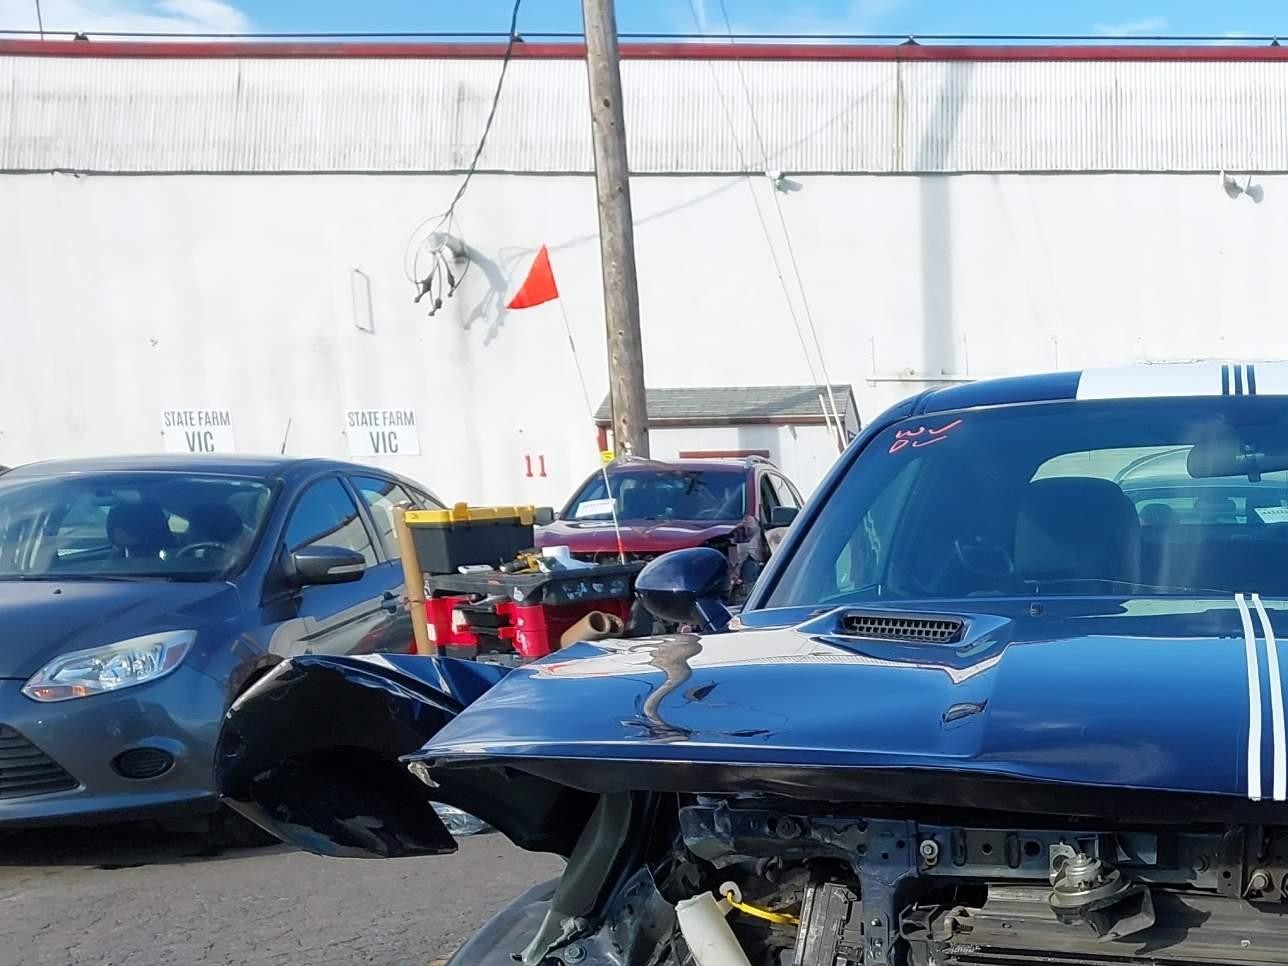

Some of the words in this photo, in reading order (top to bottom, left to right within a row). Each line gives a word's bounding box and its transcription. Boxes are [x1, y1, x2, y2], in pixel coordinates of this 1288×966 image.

[163, 411, 197, 427] STATE
[198, 410, 231, 426] FARM
[347, 411, 380, 427] STATE
[381, 410, 415, 426] FARM
[185, 431, 215, 452] VIC
[369, 431, 399, 453] VIC
[525, 454, 547, 477] 11
